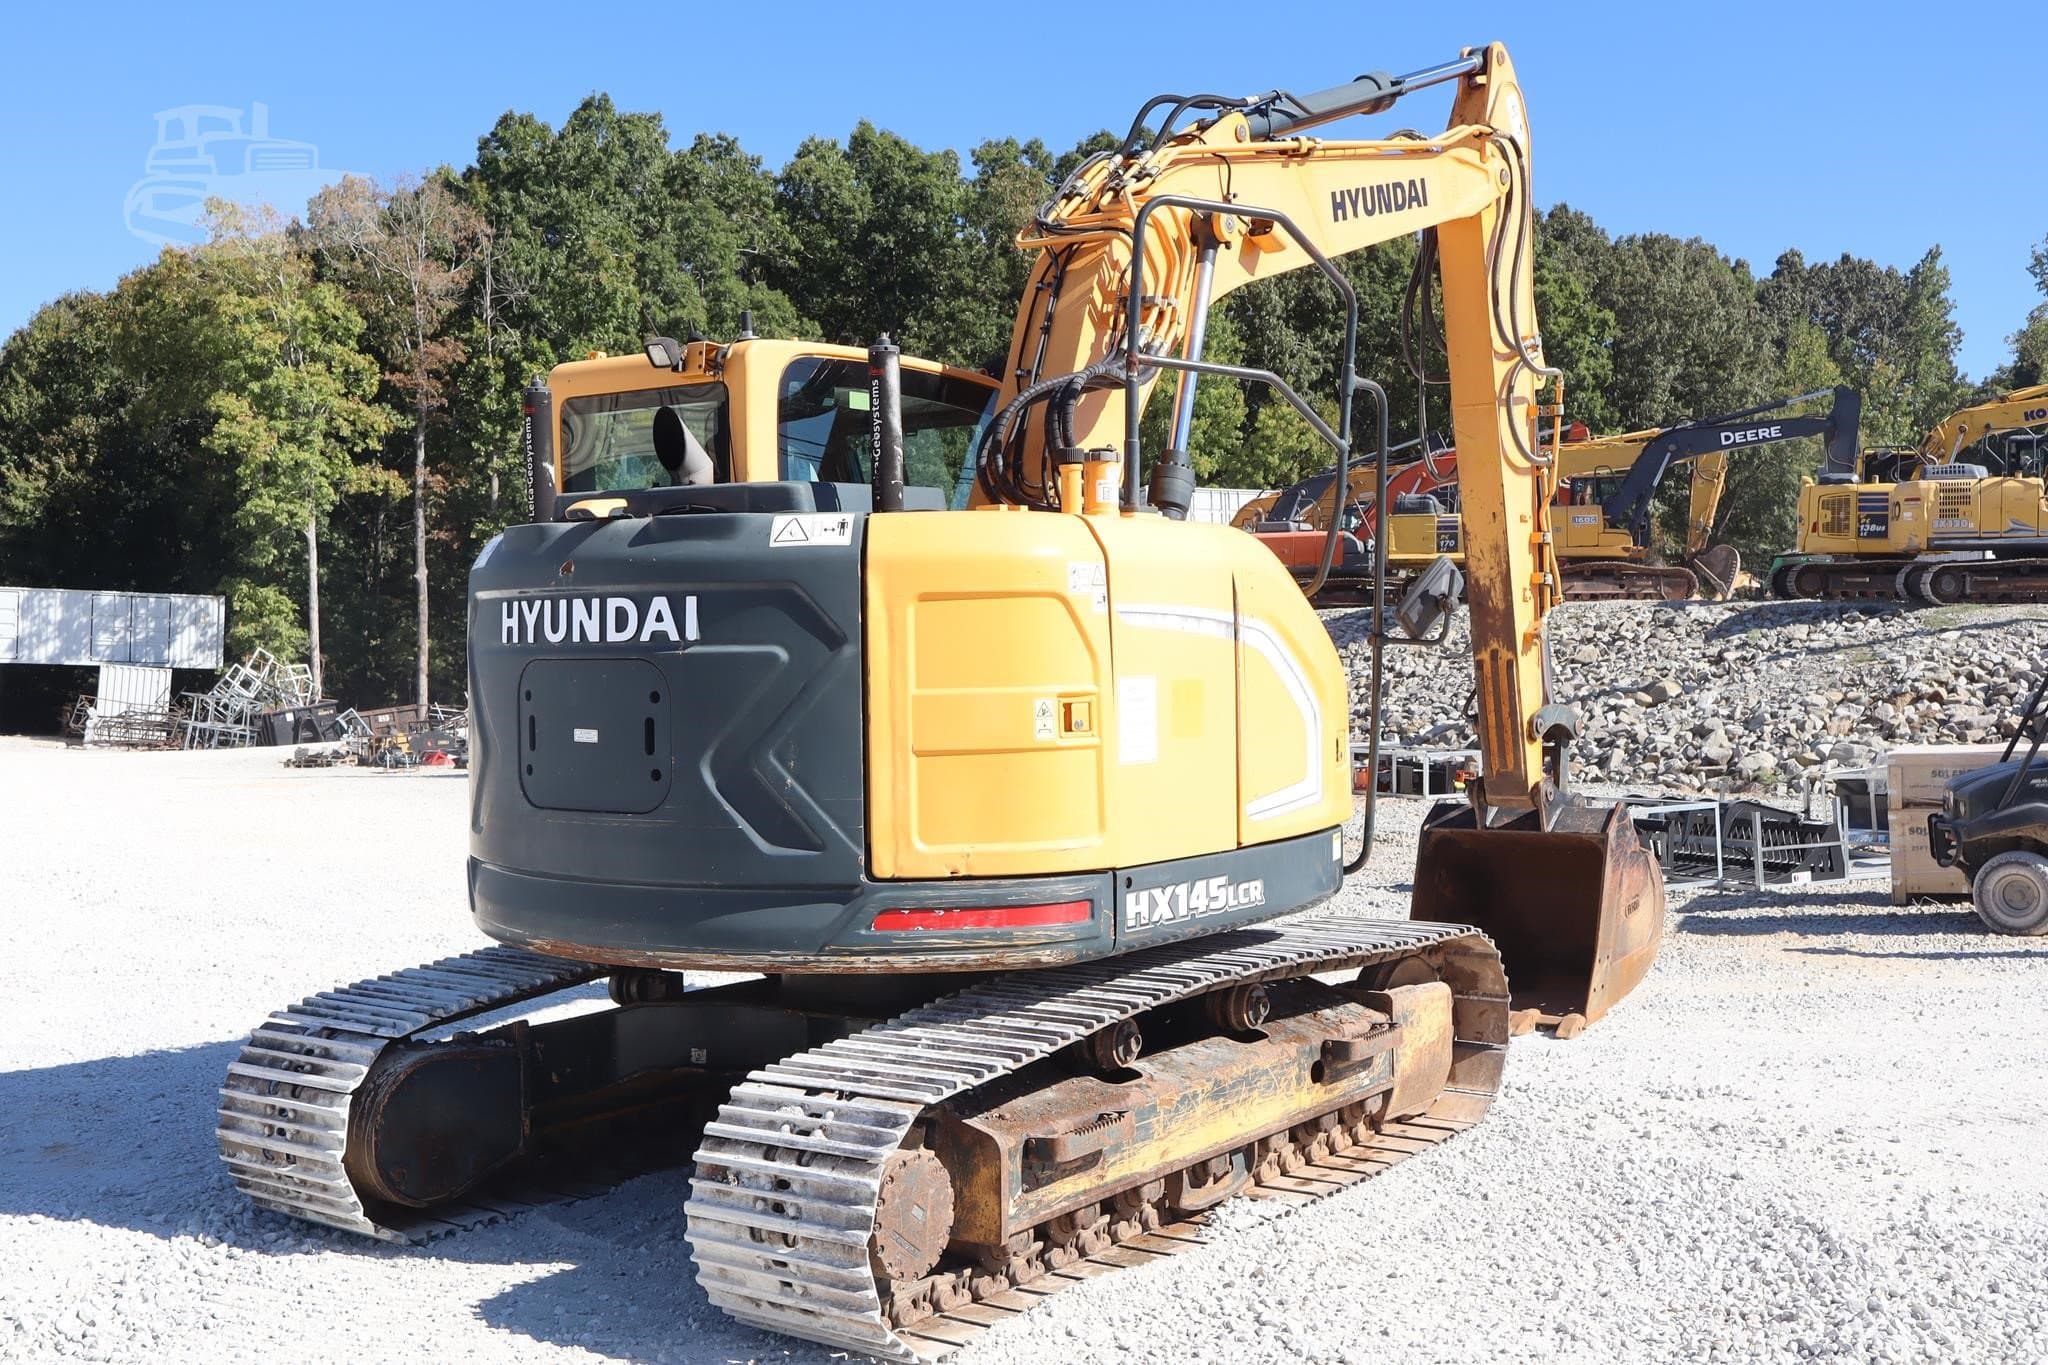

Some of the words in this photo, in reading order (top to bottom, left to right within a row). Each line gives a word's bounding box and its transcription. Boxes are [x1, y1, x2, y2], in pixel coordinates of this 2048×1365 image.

[1330, 177, 1429, 223] HYUNDAI
[2023, 408, 2048, 422] KO
[1719, 425, 1783, 446] DEERE
[501, 595, 701, 644] HYUNDAI
